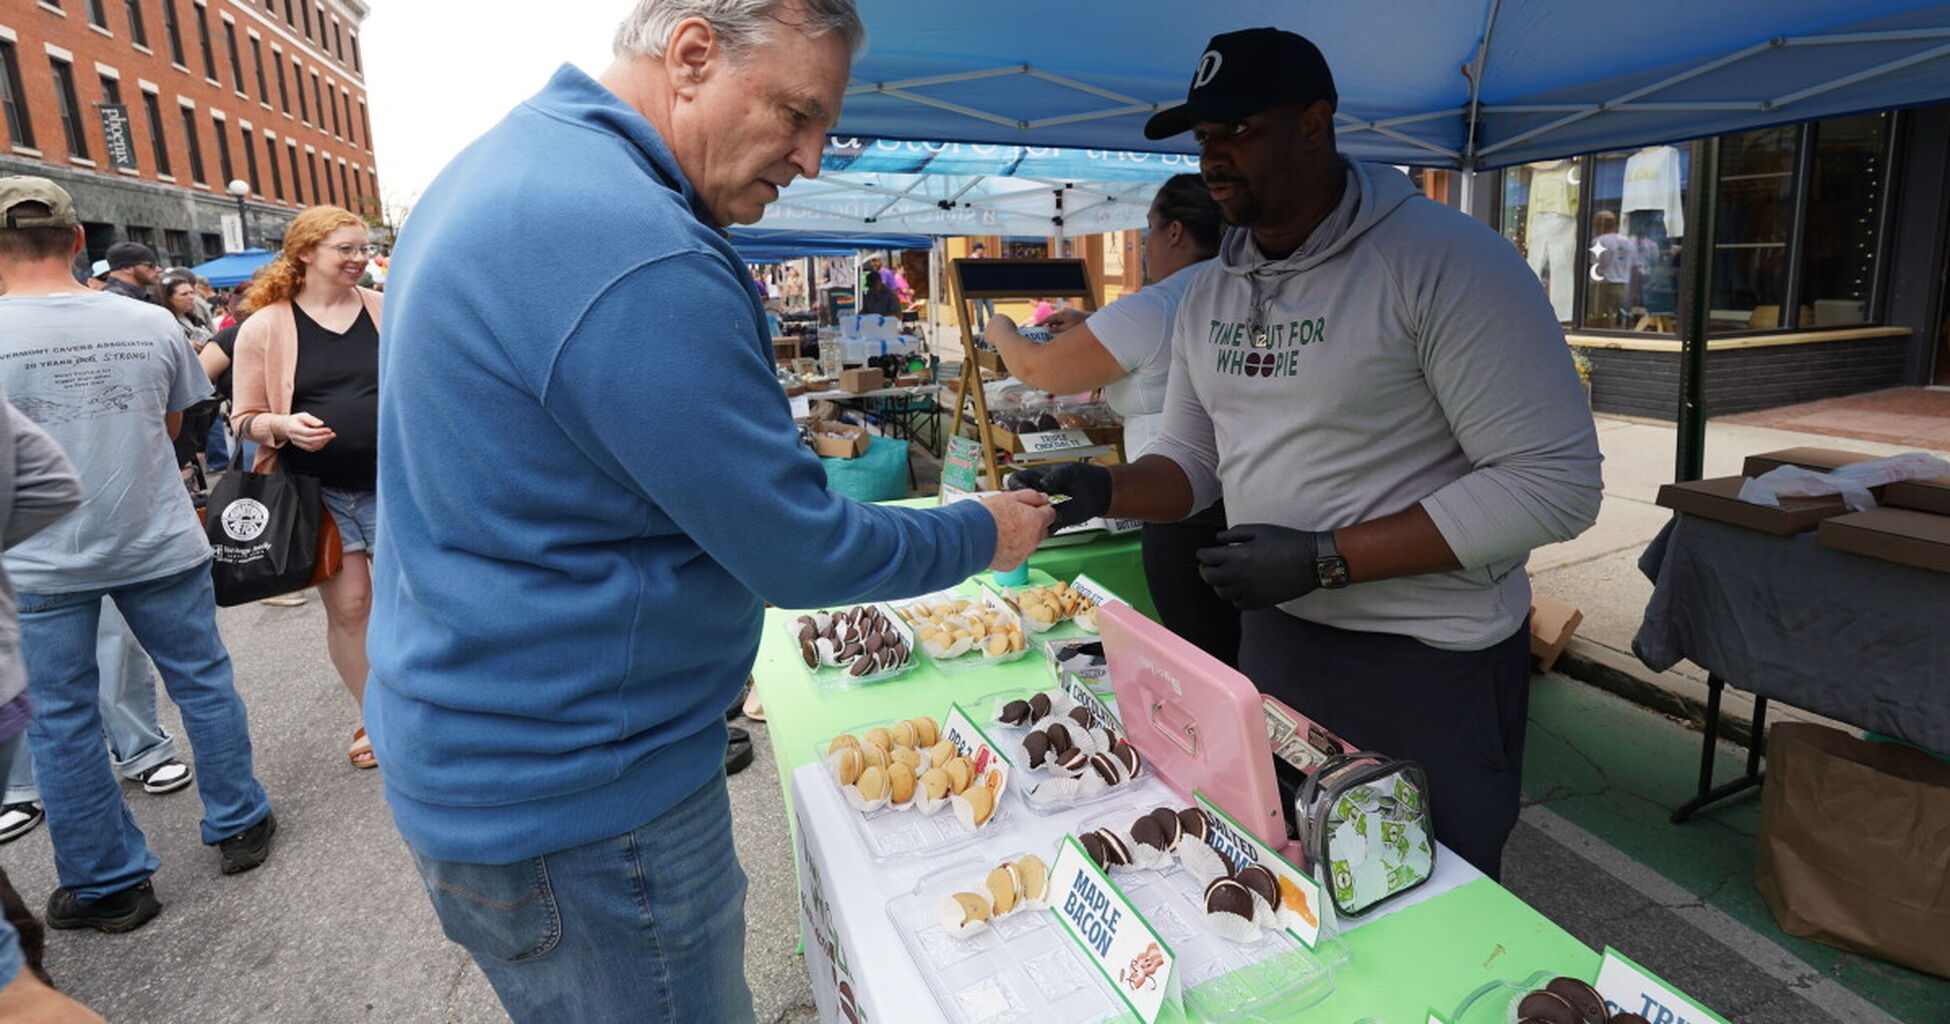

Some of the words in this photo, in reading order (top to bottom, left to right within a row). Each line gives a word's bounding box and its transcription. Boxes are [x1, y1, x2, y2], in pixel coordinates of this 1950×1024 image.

[1194, 50, 1223, 90] D
[101, 108, 128, 163] phoenix
[0, 348, 49, 360] VERMONT
[1208, 319, 1246, 347] TIME
[1288, 316, 1326, 348] FOR
[1206, 810, 1259, 862] SALTED
[1063, 890, 1114, 959] BACON
[1073, 868, 1122, 935] MAPLE
